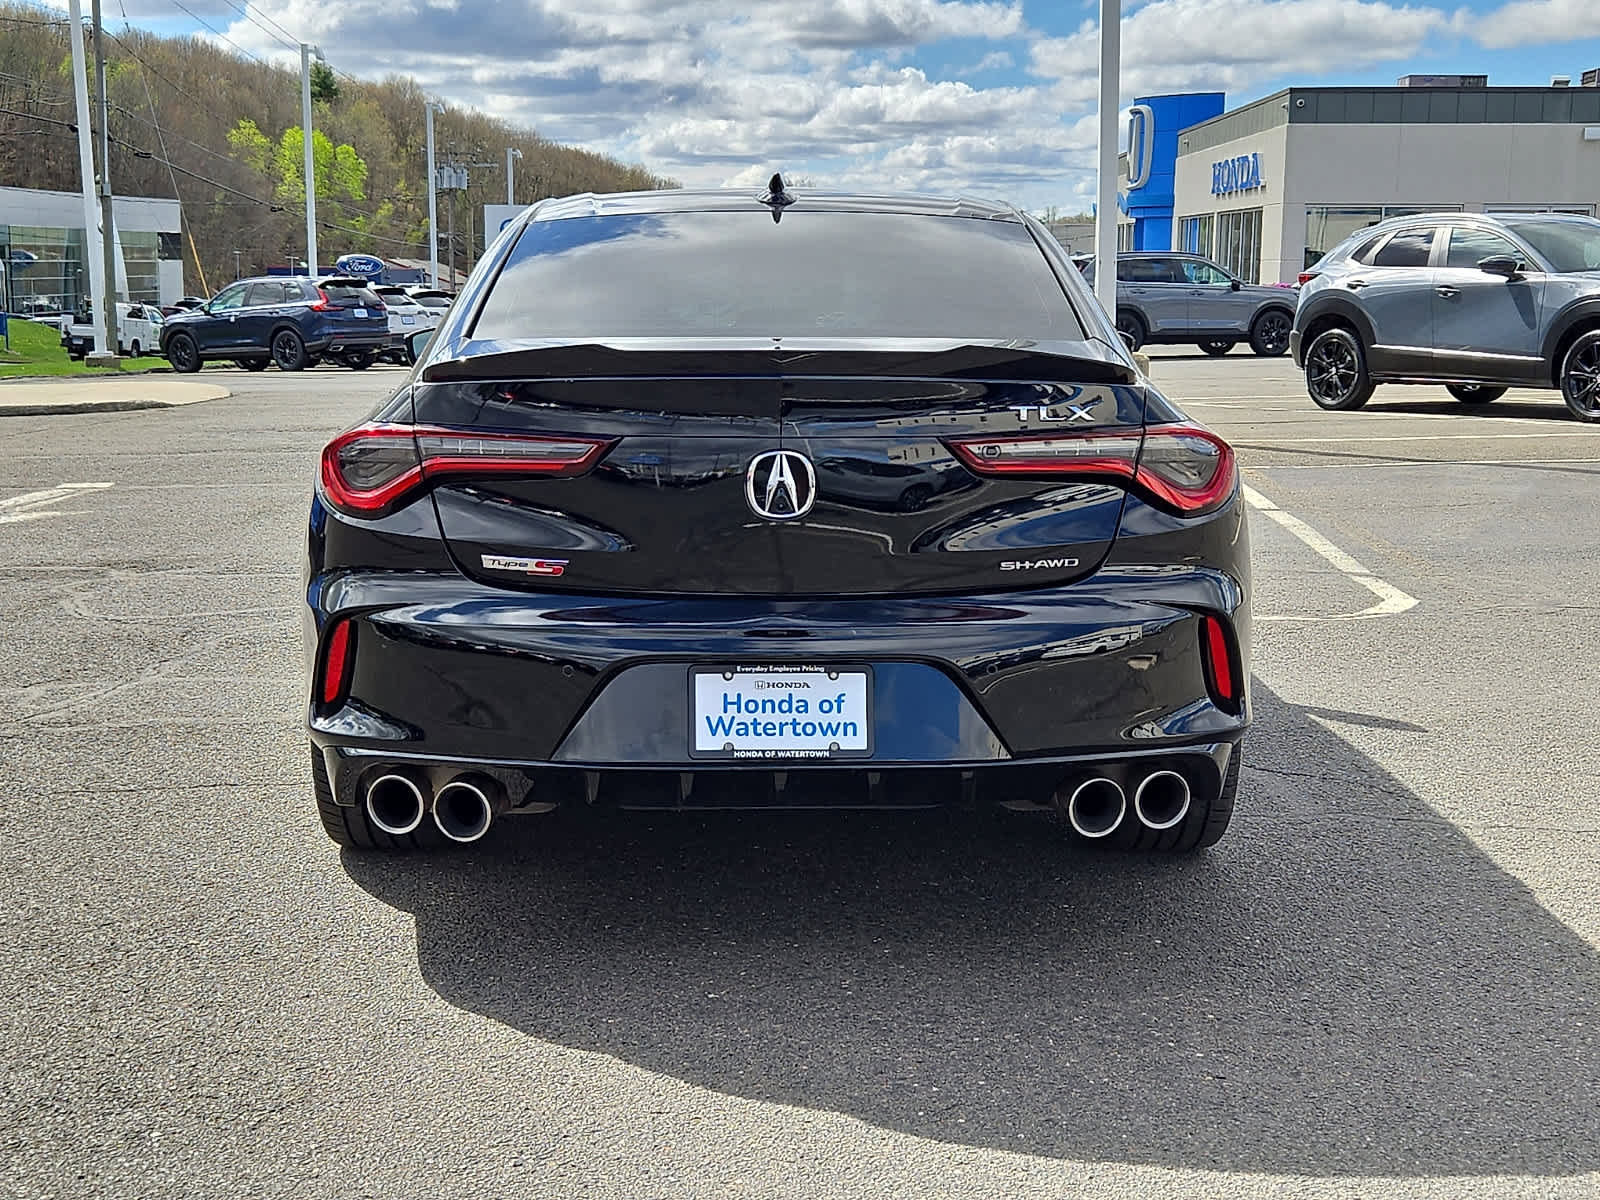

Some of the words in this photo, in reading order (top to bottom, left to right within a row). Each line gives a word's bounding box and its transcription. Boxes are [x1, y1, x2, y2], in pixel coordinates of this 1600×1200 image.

[1211, 153, 1262, 194] HONDA
[346, 260, 374, 271] Ford
[1007, 405, 1096, 421] TLX
[490, 559, 529, 568] Type
[527, 560, 569, 576] S
[736, 665, 768, 673] Everyday
[769, 665, 800, 673] Employee
[801, 665, 825, 673] Pricing
[766, 681, 811, 689] HONDA
[722, 692, 809, 714] Honda
[818, 692, 846, 714] of
[705, 715, 858, 737] Watertown
[734, 750, 764, 758] HONDA
[765, 750, 776, 758] OF
[777, 750, 830, 758] WATERTOWN
